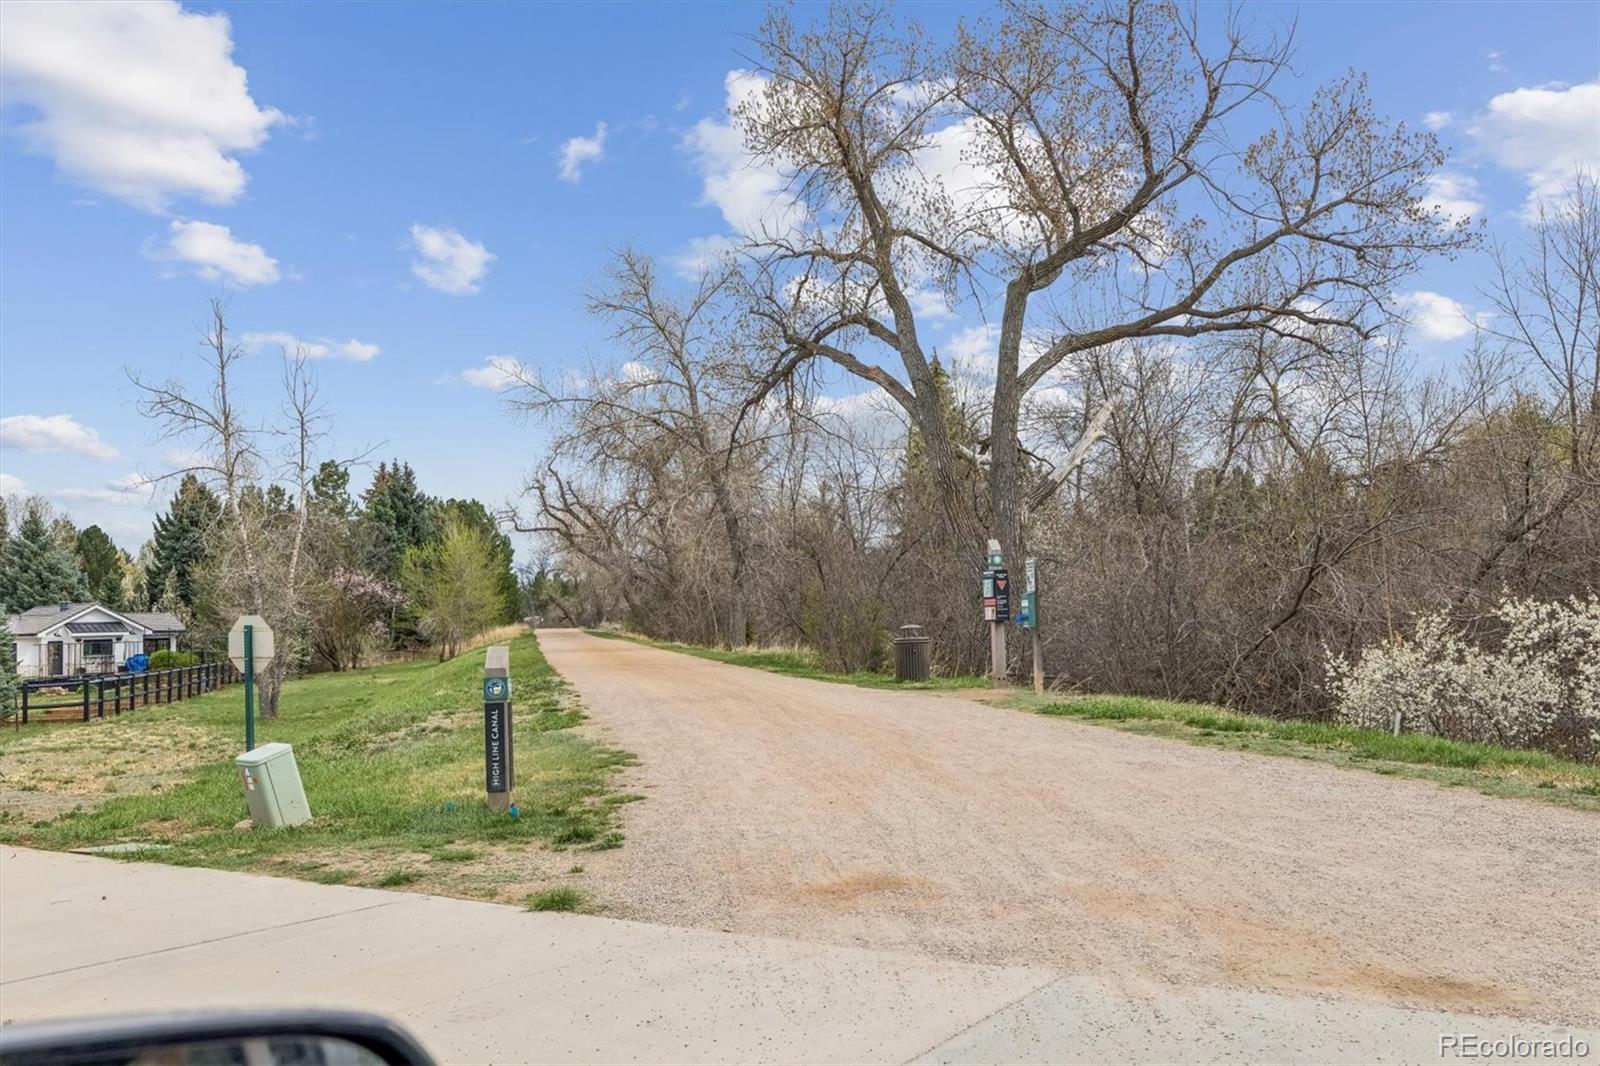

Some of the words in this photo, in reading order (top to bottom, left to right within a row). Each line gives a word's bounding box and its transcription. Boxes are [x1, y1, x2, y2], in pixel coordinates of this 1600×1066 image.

[490, 709, 499, 740] CANAL
[491, 741, 500, 761] LINE
[492, 763, 500, 786] HIGH
